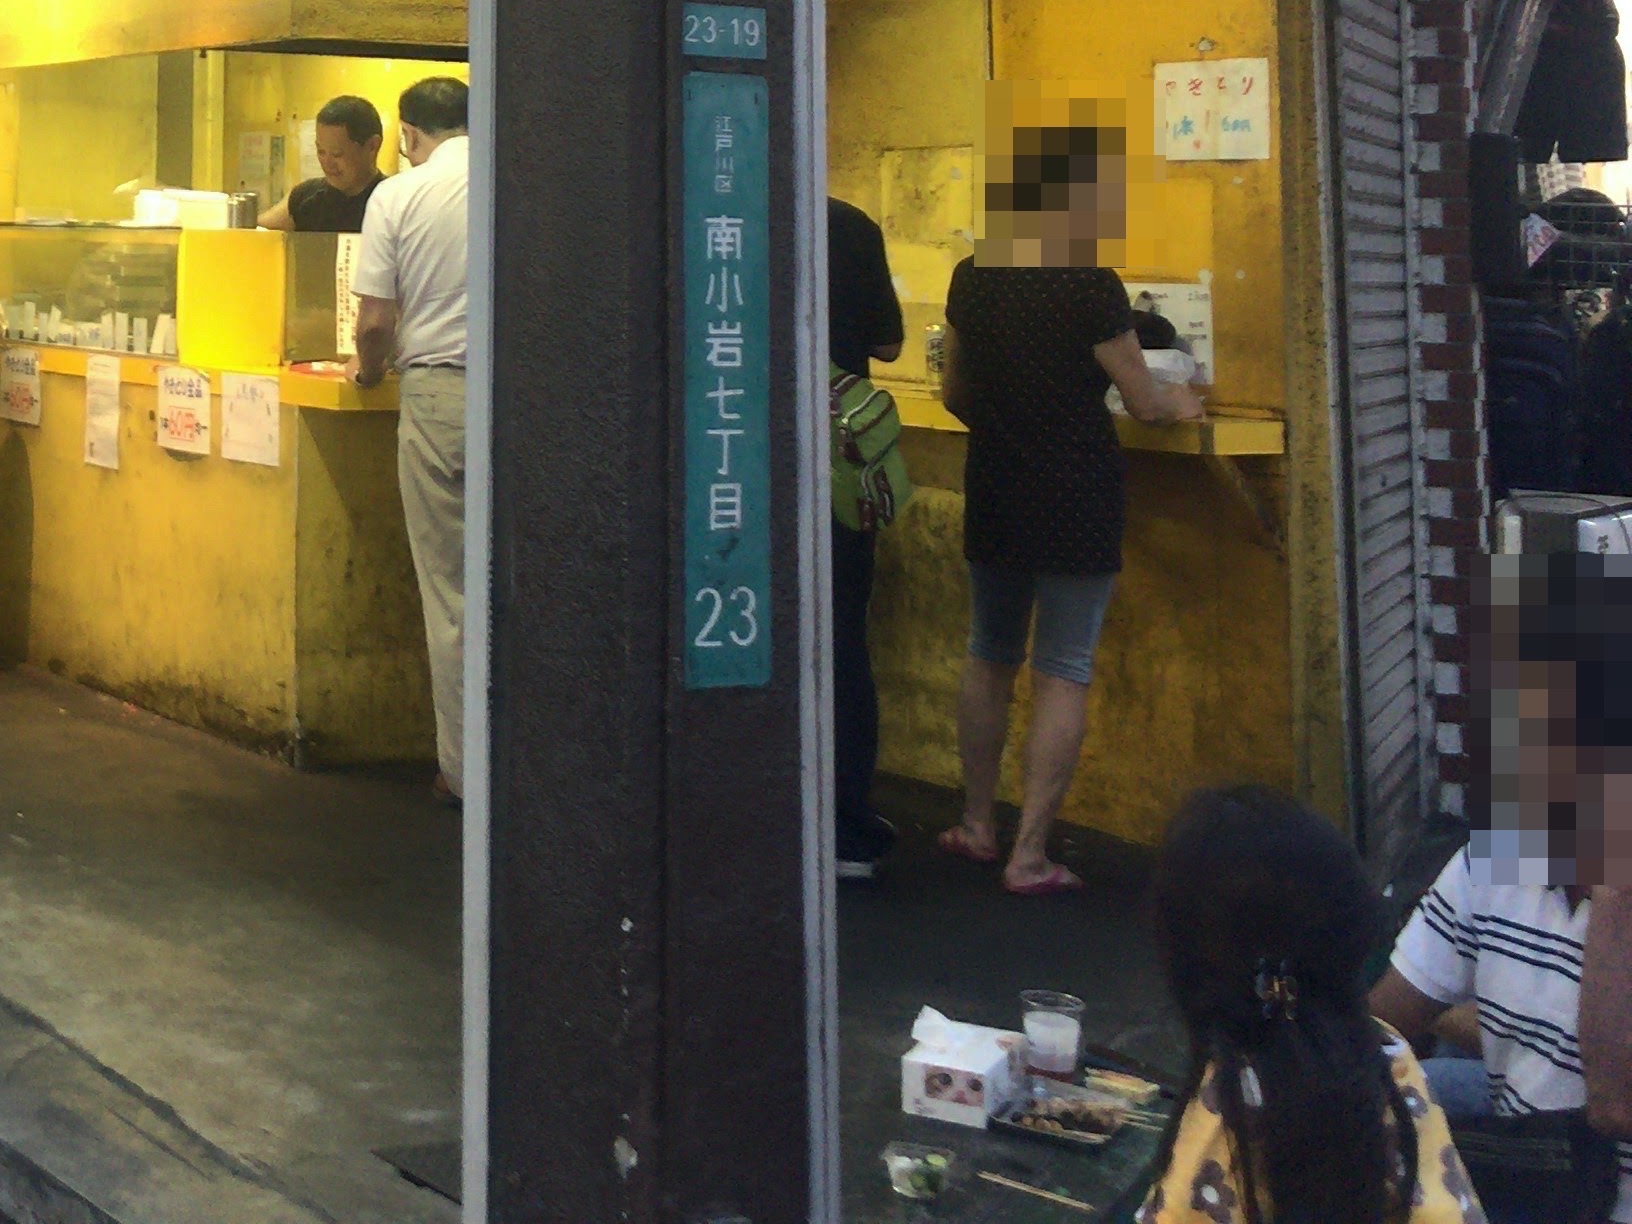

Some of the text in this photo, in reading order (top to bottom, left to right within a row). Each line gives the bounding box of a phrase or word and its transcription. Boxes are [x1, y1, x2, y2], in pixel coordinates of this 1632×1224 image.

[684, 14, 760, 47] 23-19
[715, 115, 734, 194] 江戸川区
[704, 214, 745, 531] 南小岩七丁目
[694, 585, 759, 647] 23
